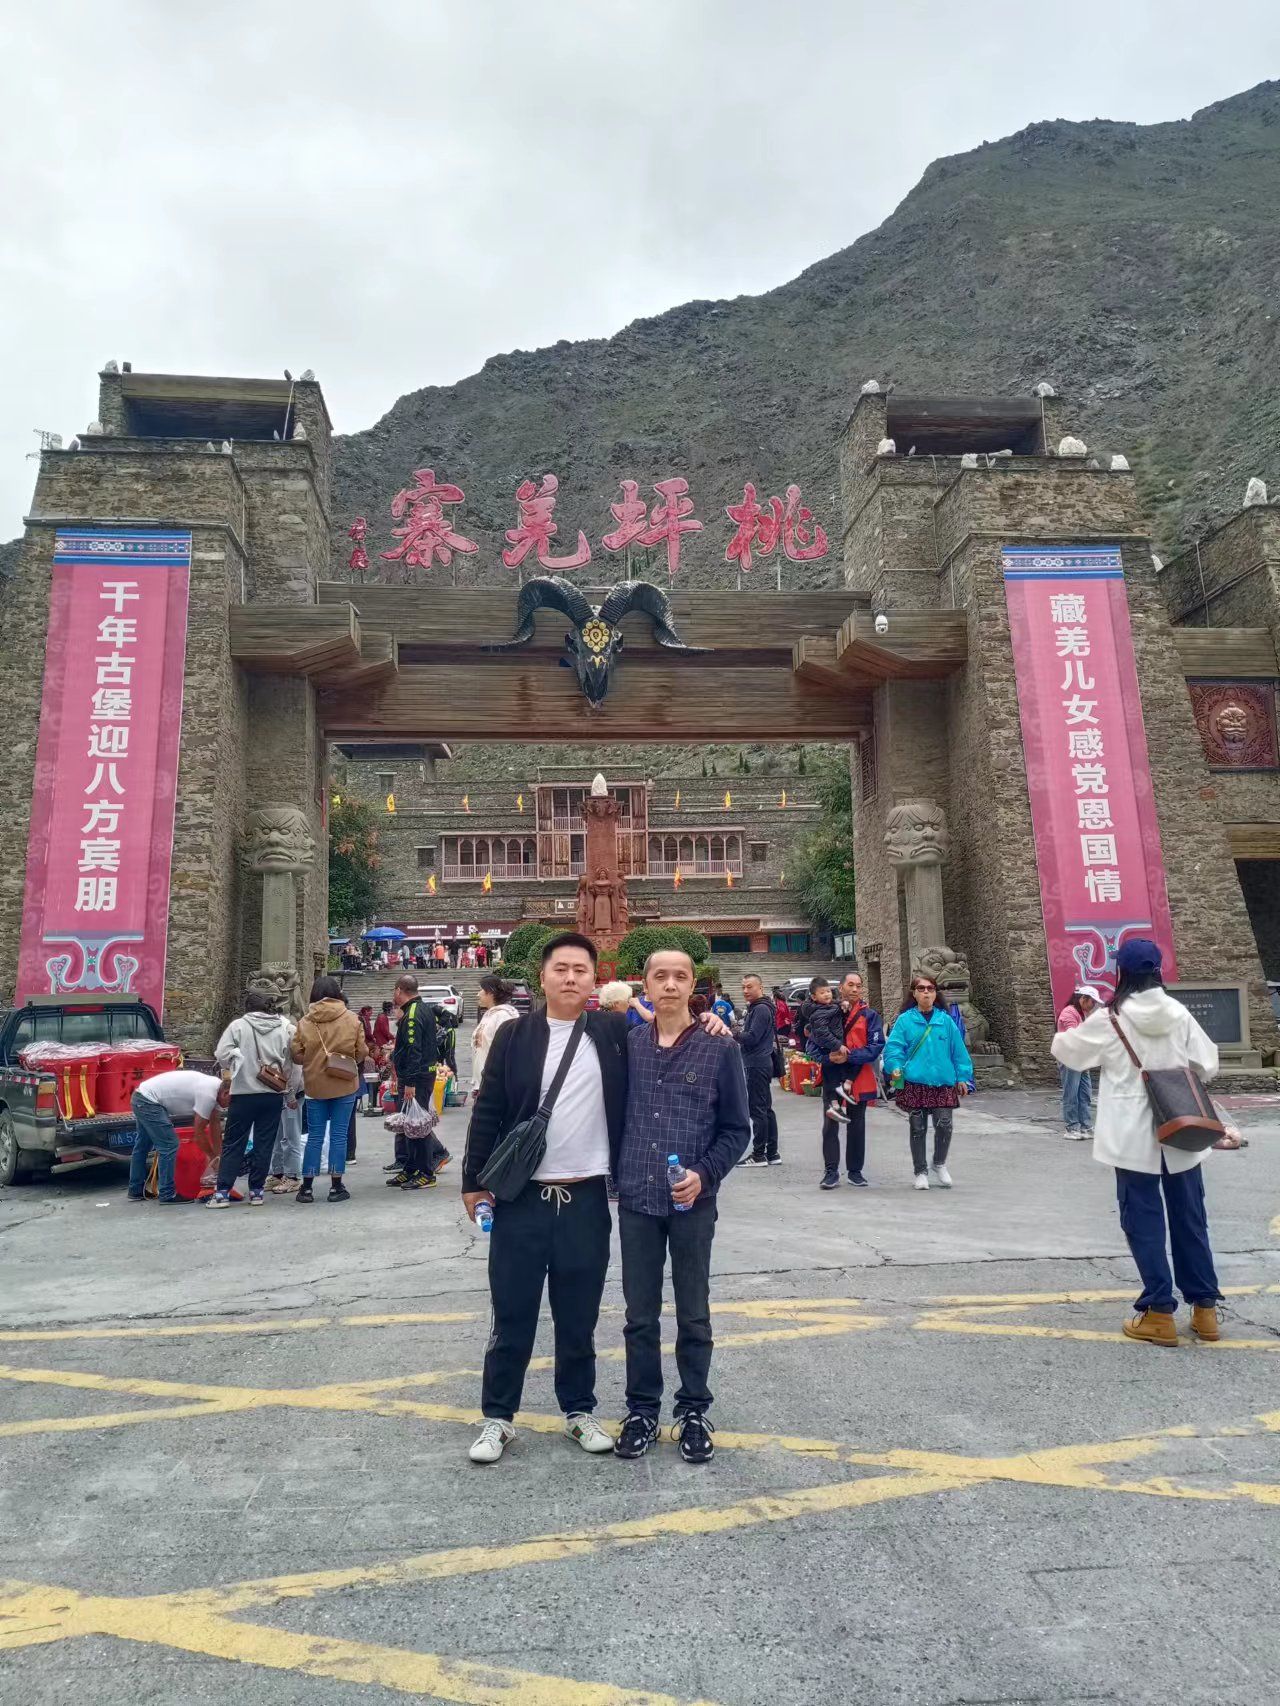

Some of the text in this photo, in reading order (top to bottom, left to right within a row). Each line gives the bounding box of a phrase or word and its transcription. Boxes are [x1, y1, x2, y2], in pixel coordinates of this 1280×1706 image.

[74, 581, 140, 912] 千年古堡迎八方宾朋
[1049, 593, 1122, 904] 藏羌儿女感党恩国情
